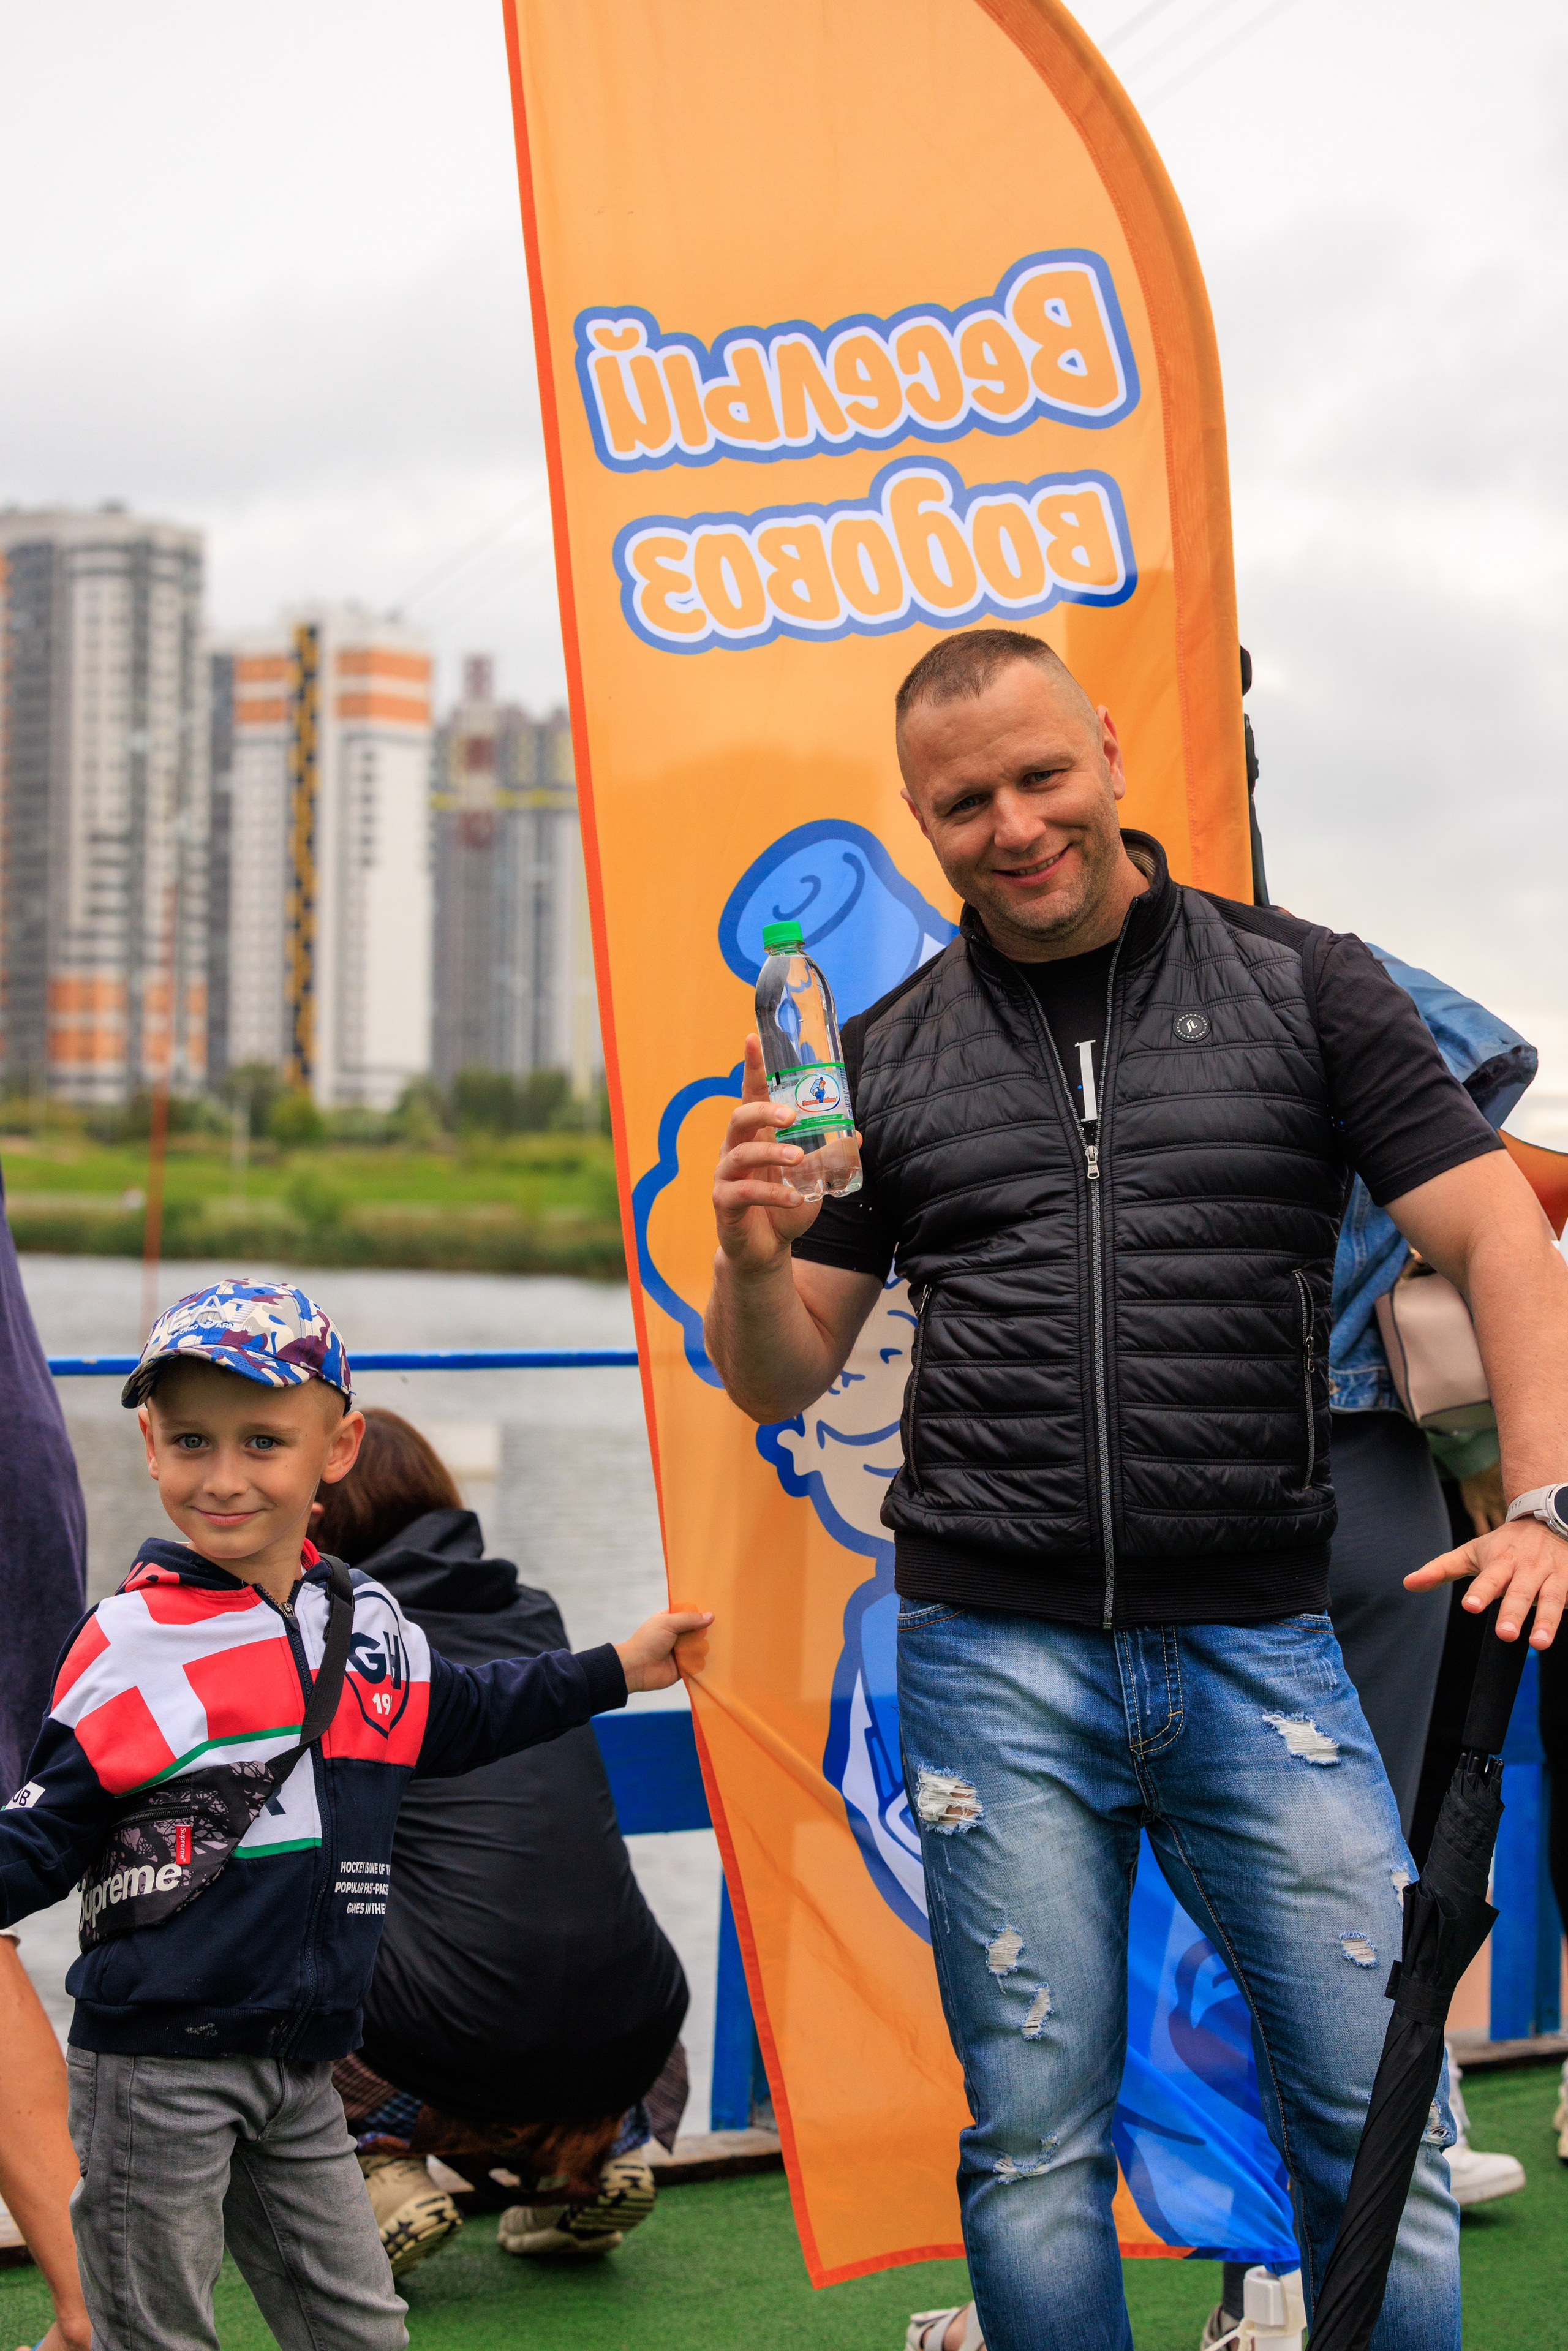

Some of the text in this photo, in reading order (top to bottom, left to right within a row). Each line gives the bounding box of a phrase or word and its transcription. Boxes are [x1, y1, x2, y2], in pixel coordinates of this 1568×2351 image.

[167, 1294, 259, 1335] EA7
[372, 1692, 393, 1715] 19
[340, 1861, 365, 1873] HOCKEY
[364, 1862, 369, 1874] IS
[379, 1863, 385, 1875] OF
[334, 1881, 364, 1894] POPULAR
[78, 1863, 182, 1931] Supreme
[347, 1902, 386, 1915] GAMES IN THE
